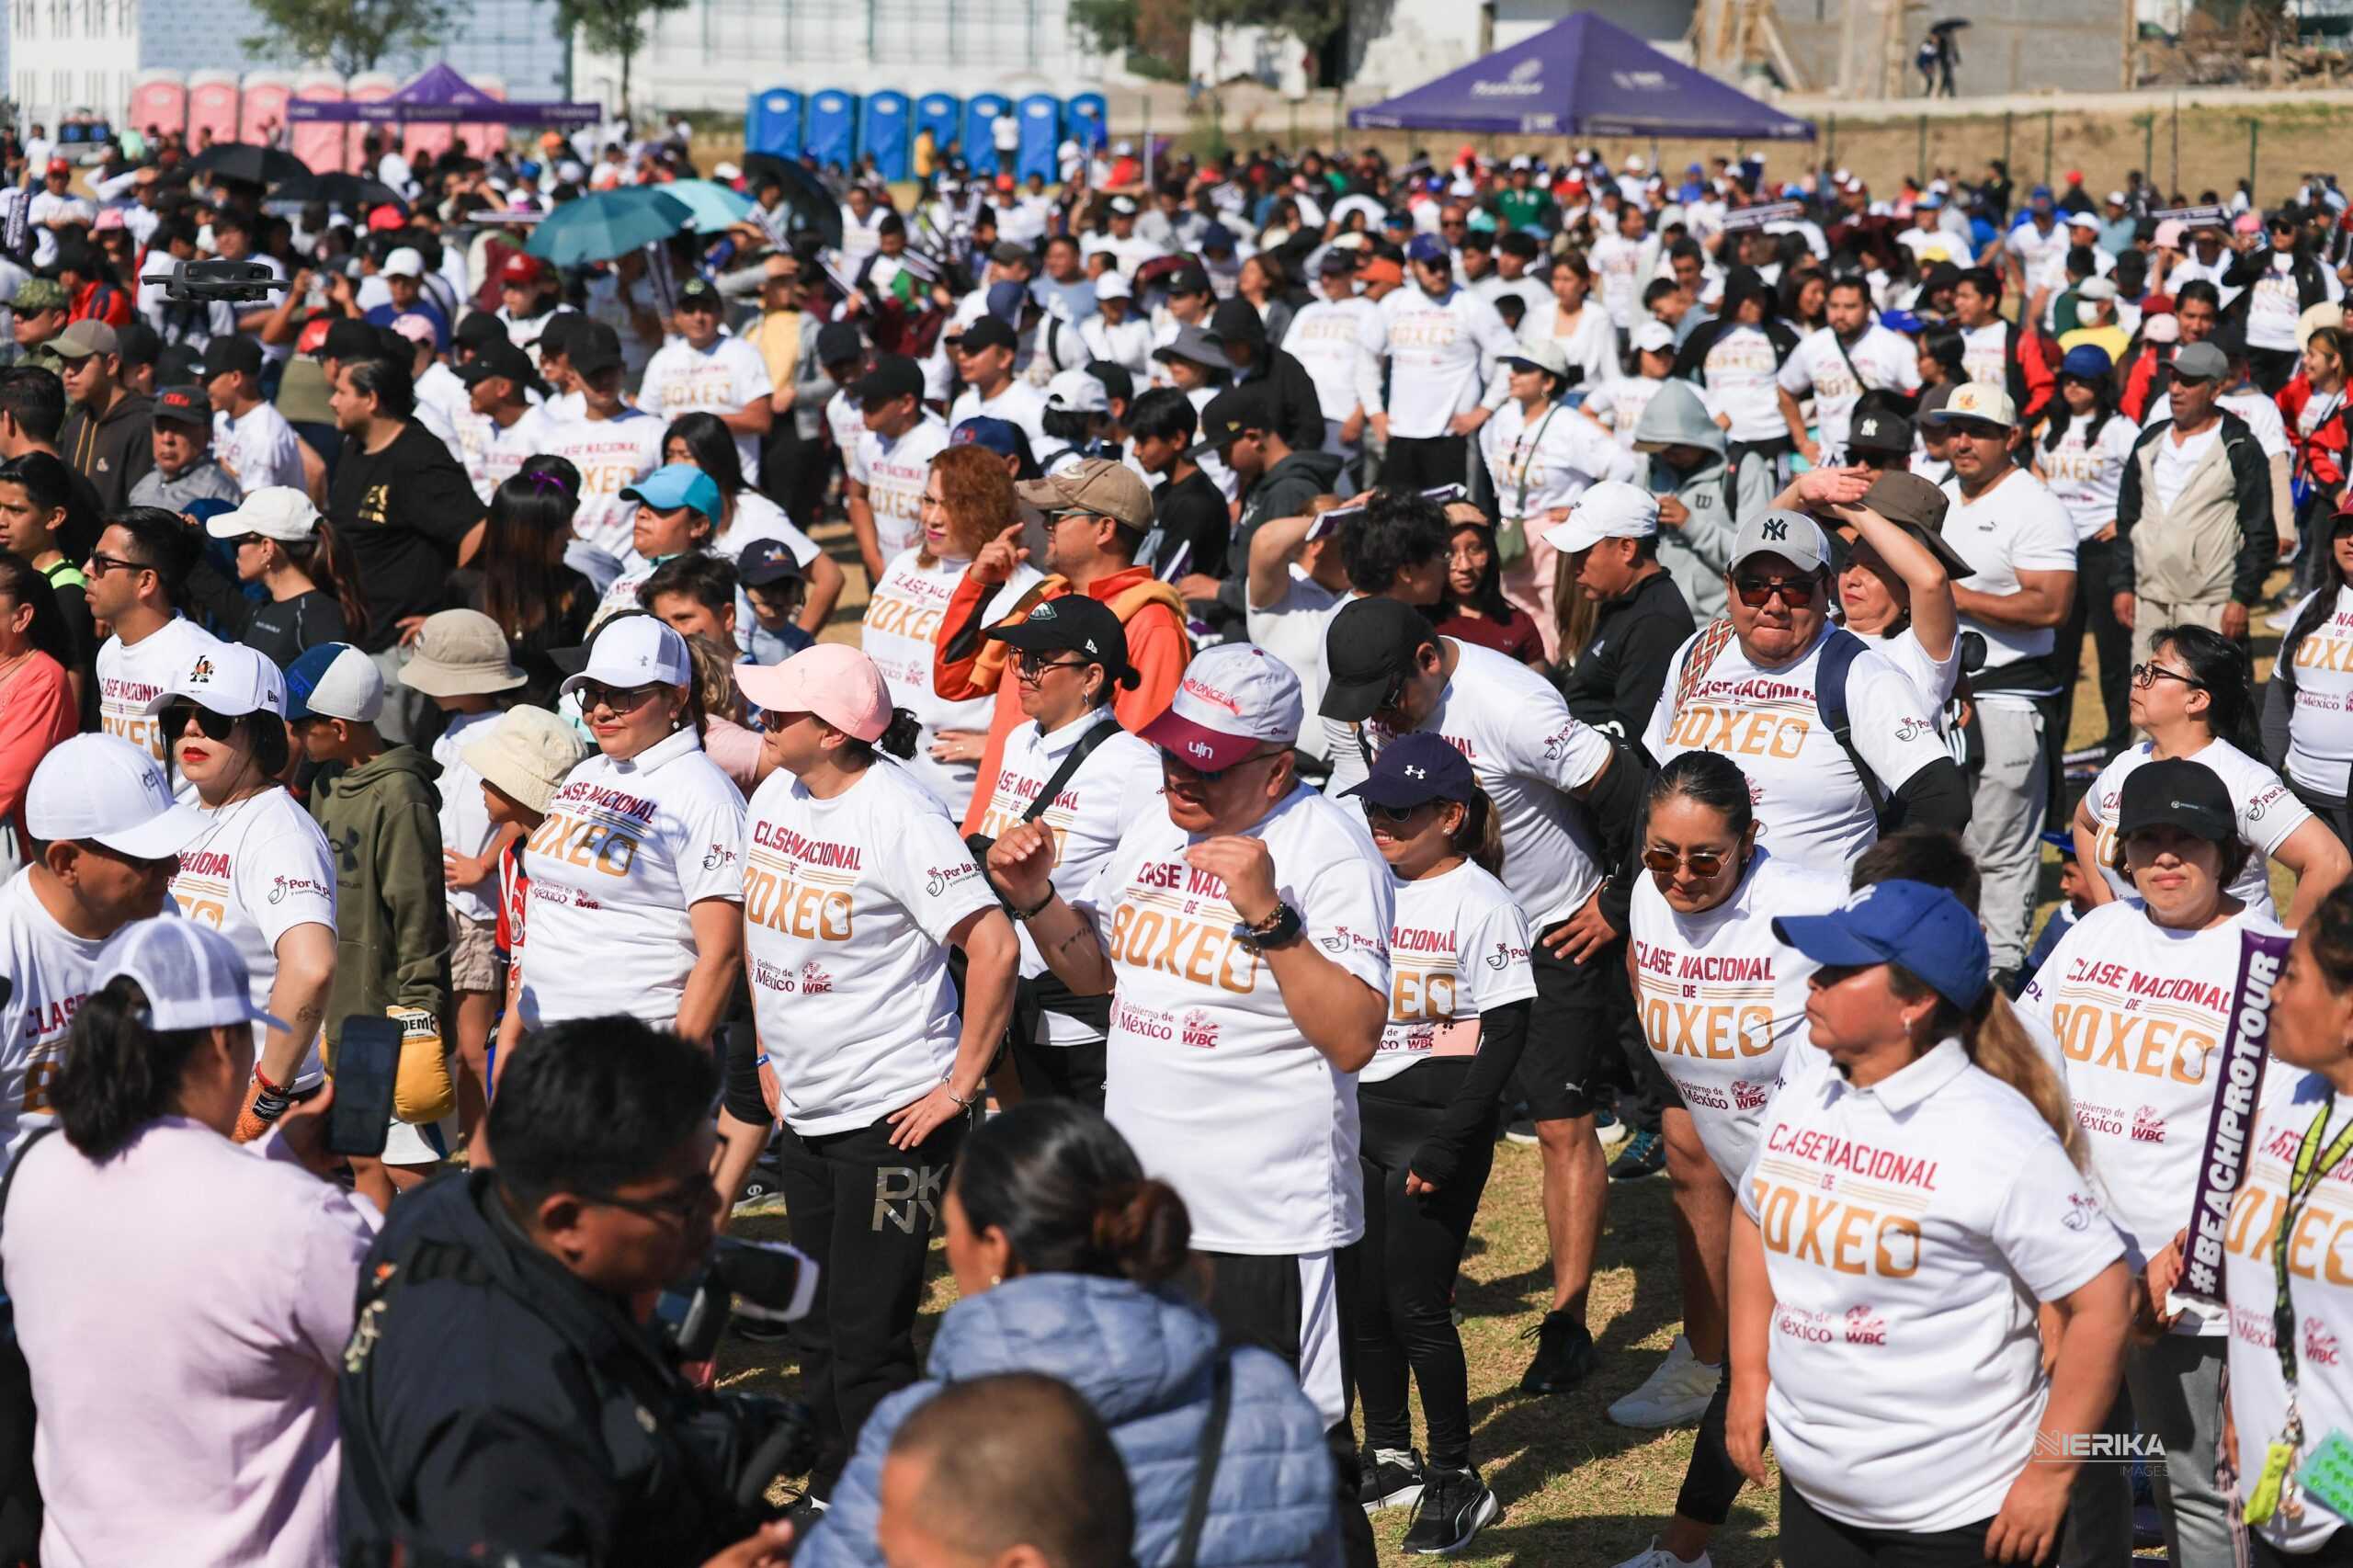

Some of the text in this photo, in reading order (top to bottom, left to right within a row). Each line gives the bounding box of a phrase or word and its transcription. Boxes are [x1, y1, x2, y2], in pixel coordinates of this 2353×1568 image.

[584, 465, 637, 493] XEO
[527, 812, 638, 877] OXEO
[1390, 925, 1456, 954] ACIONAL
[1677, 955, 1776, 982] NACIONAL
[1683, 984, 1697, 999] DE
[2124, 998, 2142, 1011] DE
[2127, 971, 2232, 1016] NACIONAL
[1120, 1012, 1173, 1041] México
[1182, 1030, 1220, 1049] WBC
[1736, 1096, 1767, 1111] WBC
[2131, 1125, 2165, 1142] WBC
[2188, 950, 2280, 1295] #BEACHPROTOUR
[1845, 1330, 1887, 1346] WBC
